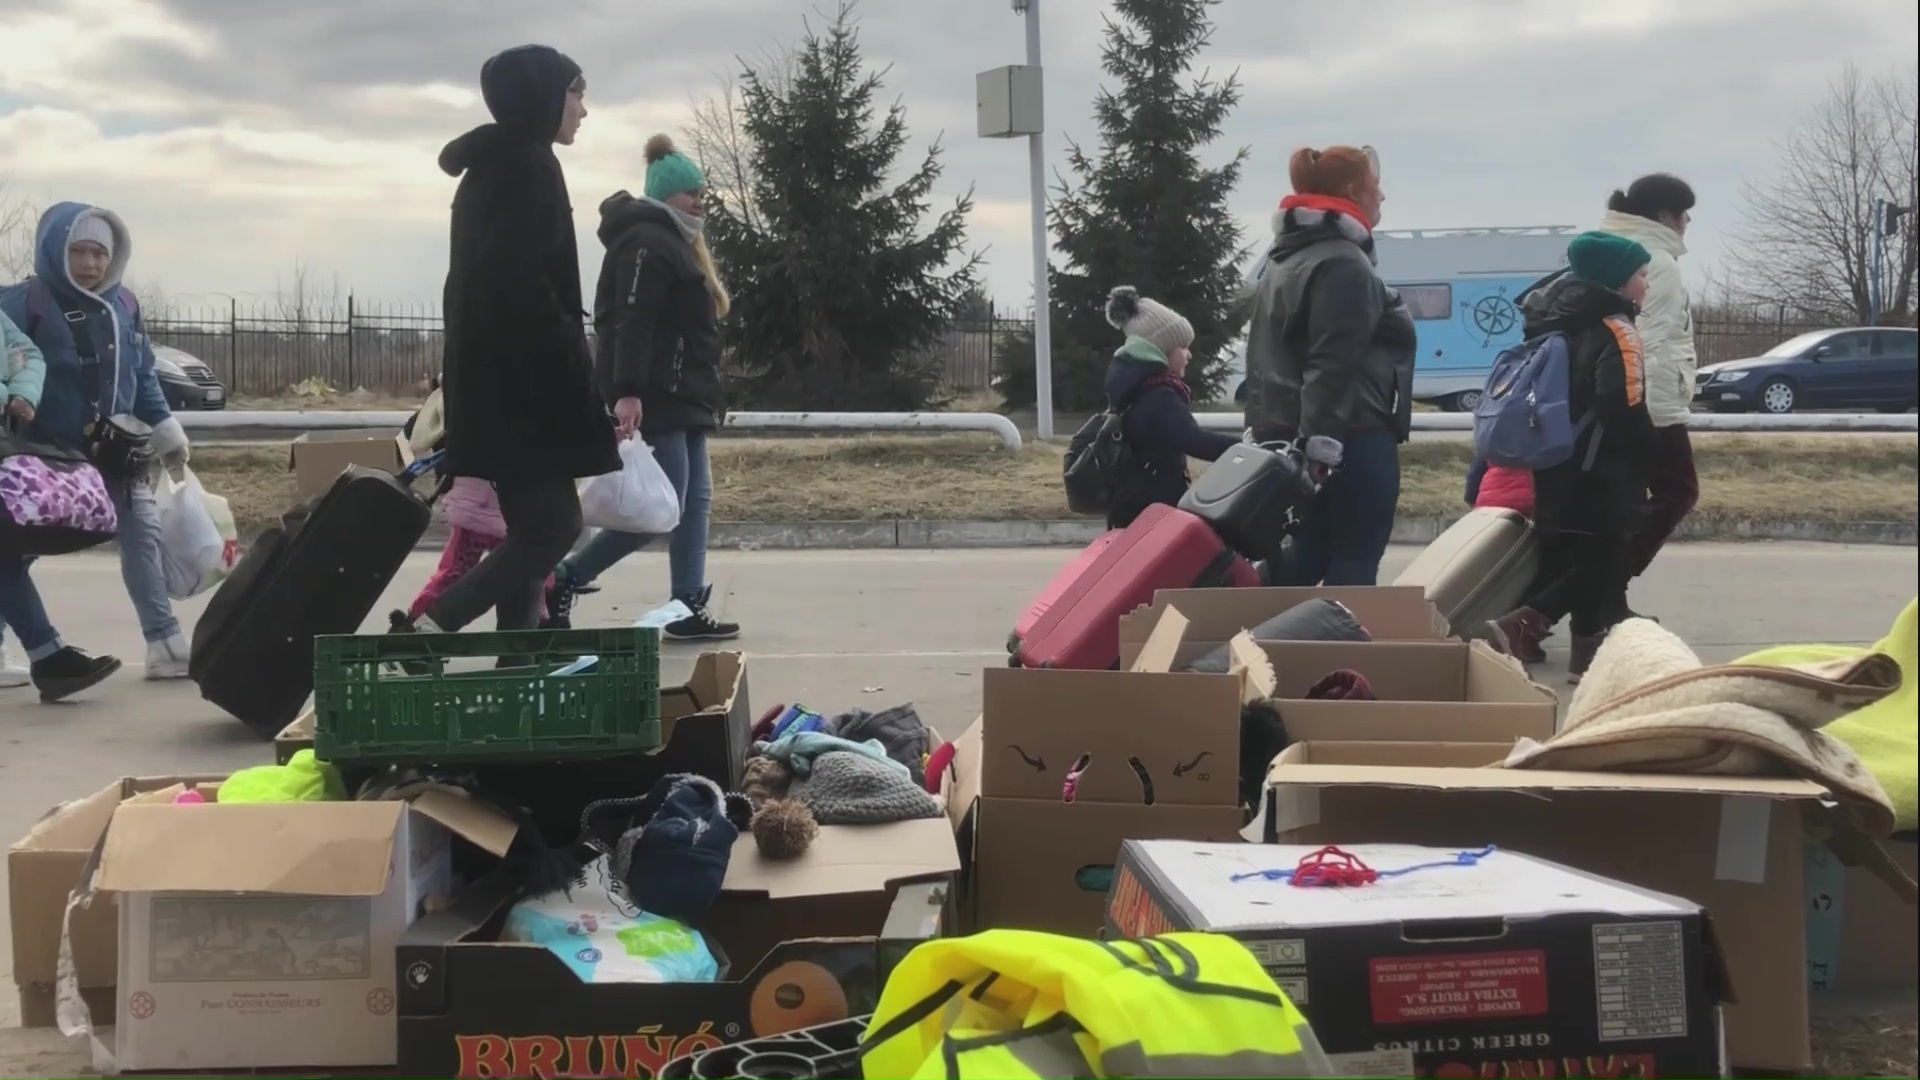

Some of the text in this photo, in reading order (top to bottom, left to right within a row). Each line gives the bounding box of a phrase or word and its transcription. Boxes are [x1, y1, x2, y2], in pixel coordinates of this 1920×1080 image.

[1377, 973, 1417, 982] GREECE
[1426, 970, 1461, 979] ARGOS
[1420, 982, 1455, 990] EXPORT
[1401, 988, 1517, 1004] EXTRA FRUIT S.A.
[226, 998, 321, 1009] CONNAISSEURS
[1477, 1000, 1521, 1012] EXPORT
[1372, 1033, 1551, 1054] GREEK CITRUS
